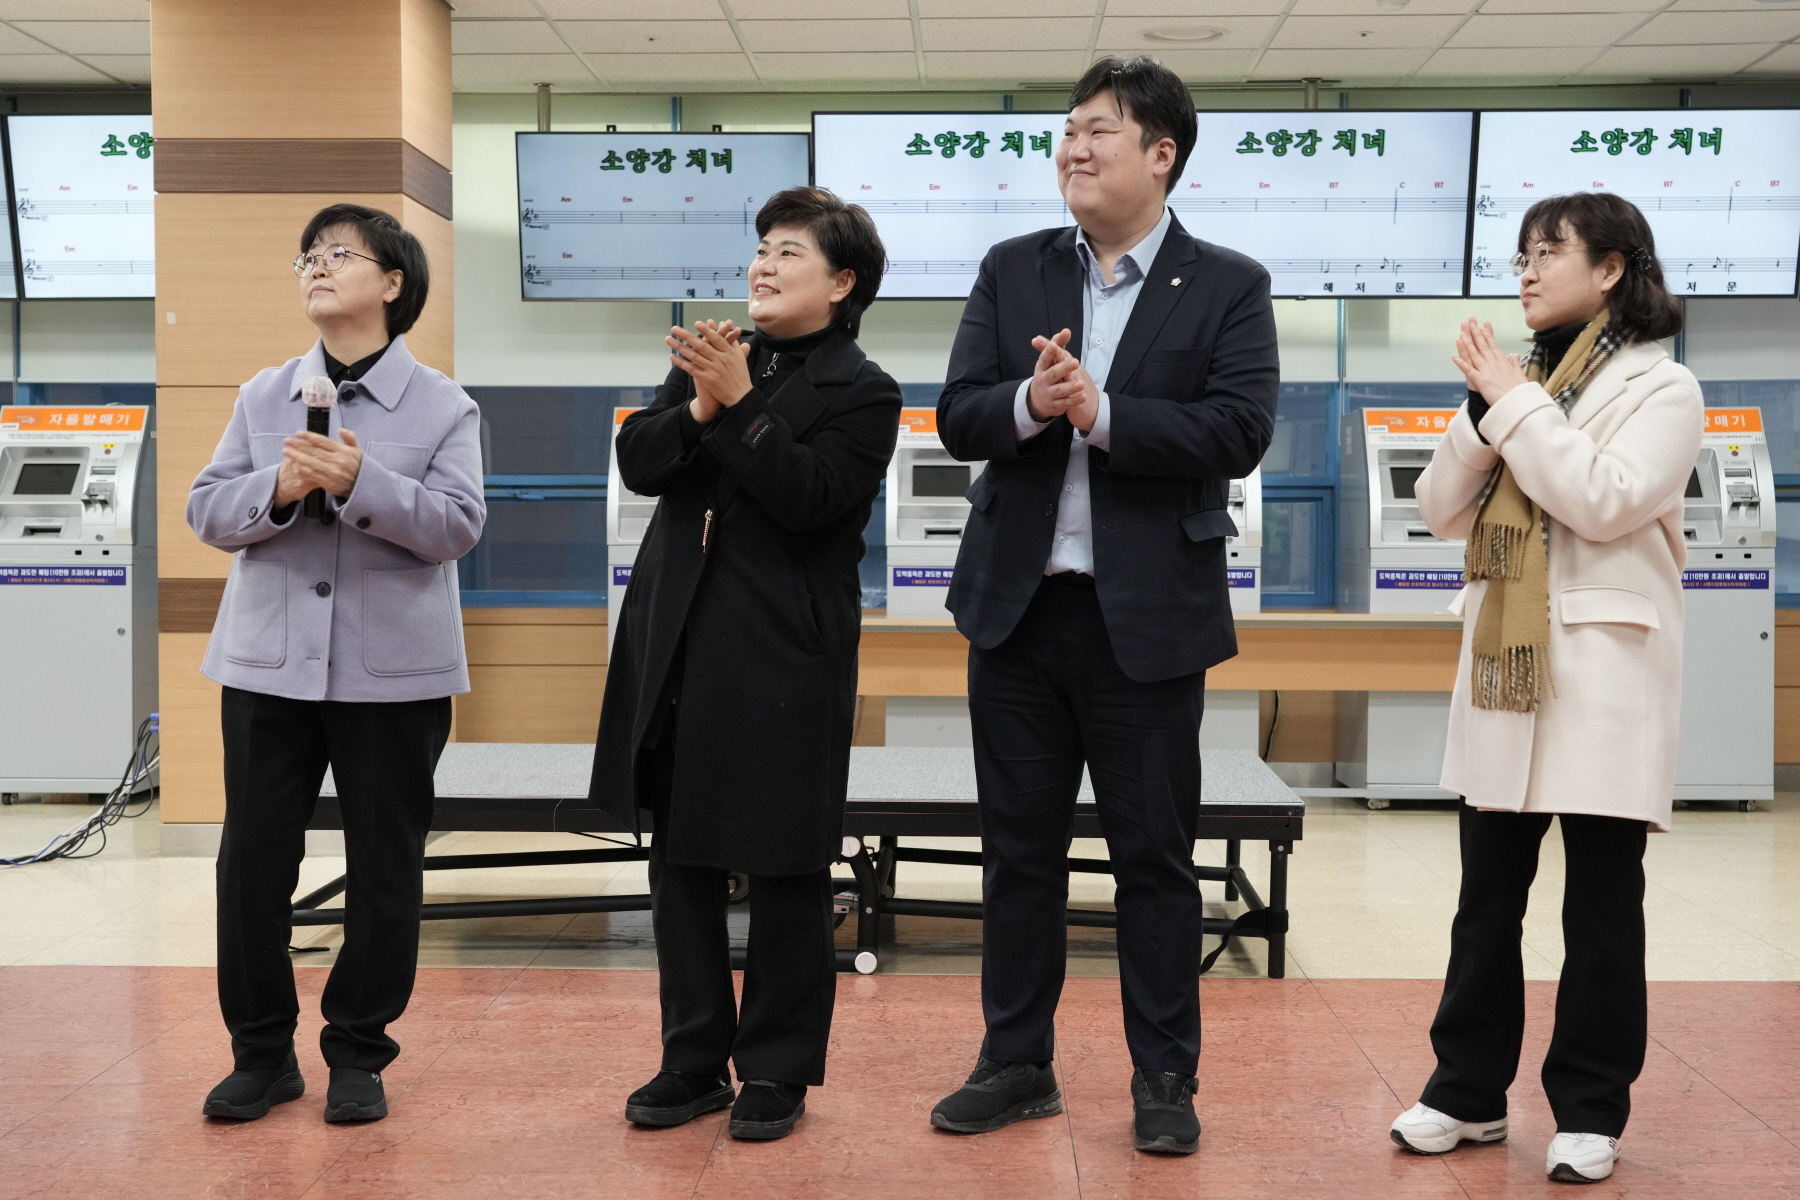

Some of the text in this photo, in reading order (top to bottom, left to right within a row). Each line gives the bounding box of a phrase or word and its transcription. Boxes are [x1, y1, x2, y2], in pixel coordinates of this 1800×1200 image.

[905, 131, 1052, 158] 소양강 처녀
[1236, 129, 1386, 157] 소양강 처녀
[1570, 128, 1723, 156] 소양강 처녀
[600, 148, 733, 174] 소양강 처녀
[686, 288, 724, 298] 해 저
[1323, 283, 1405, 292] 해 저 문
[1687, 282, 1737, 292] 저 문
[49, 413, 130, 426] 자율발매기
[1416, 415, 1455, 429] 자율
